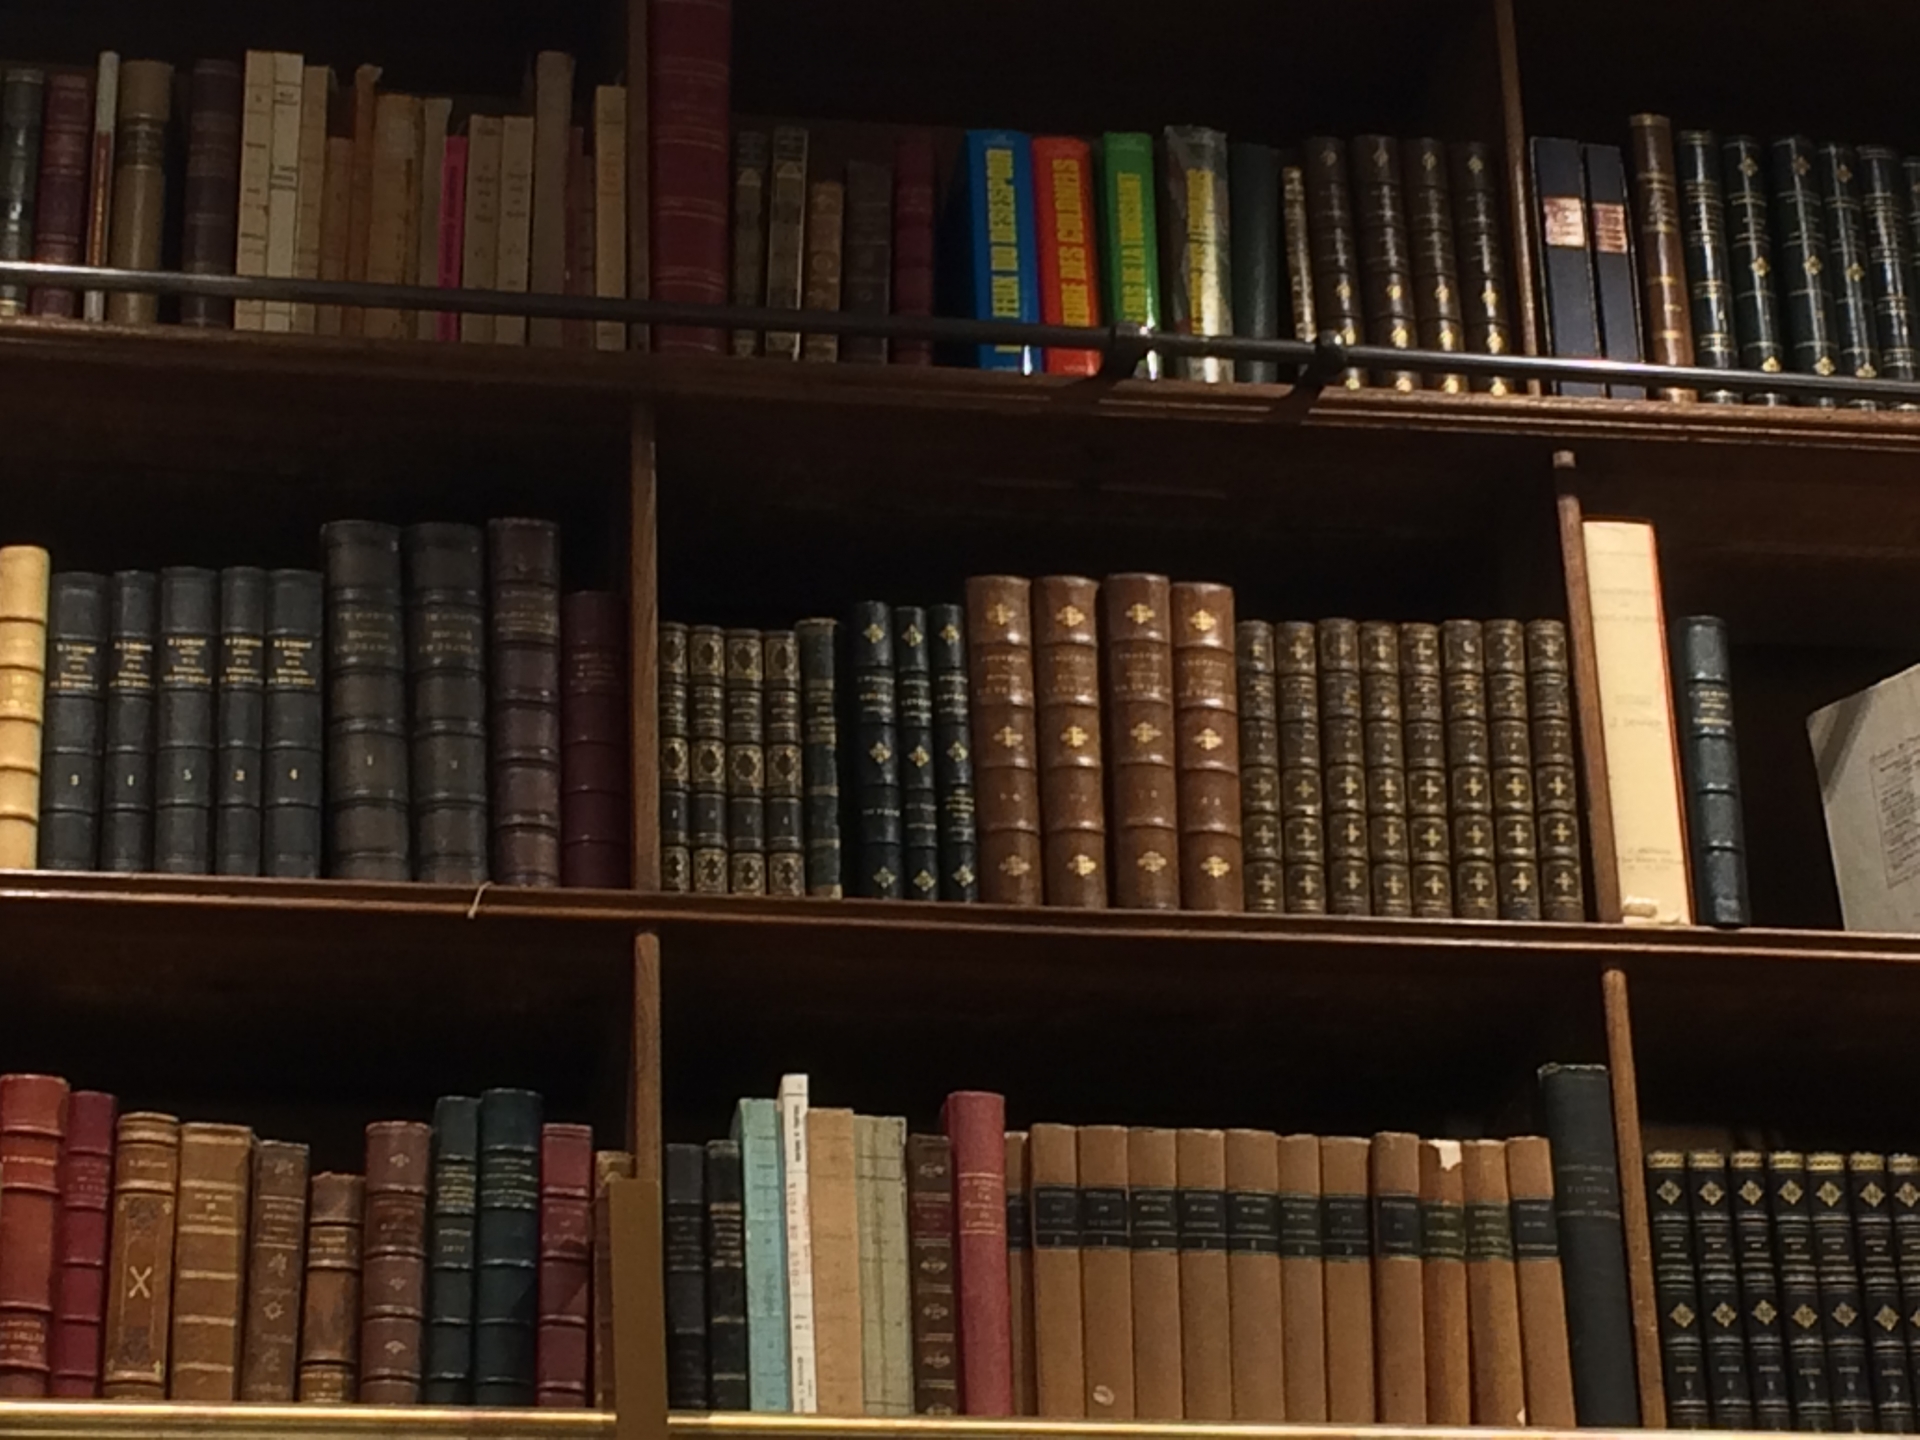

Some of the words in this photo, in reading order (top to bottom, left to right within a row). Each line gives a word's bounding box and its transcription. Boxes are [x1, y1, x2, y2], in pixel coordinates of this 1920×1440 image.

[1053, 159, 1083, 243] COLONELS
[1059, 246, 1086, 279] DES
[991, 276, 1019, 318] FEUX
[1062, 283, 1090, 328] EURE
